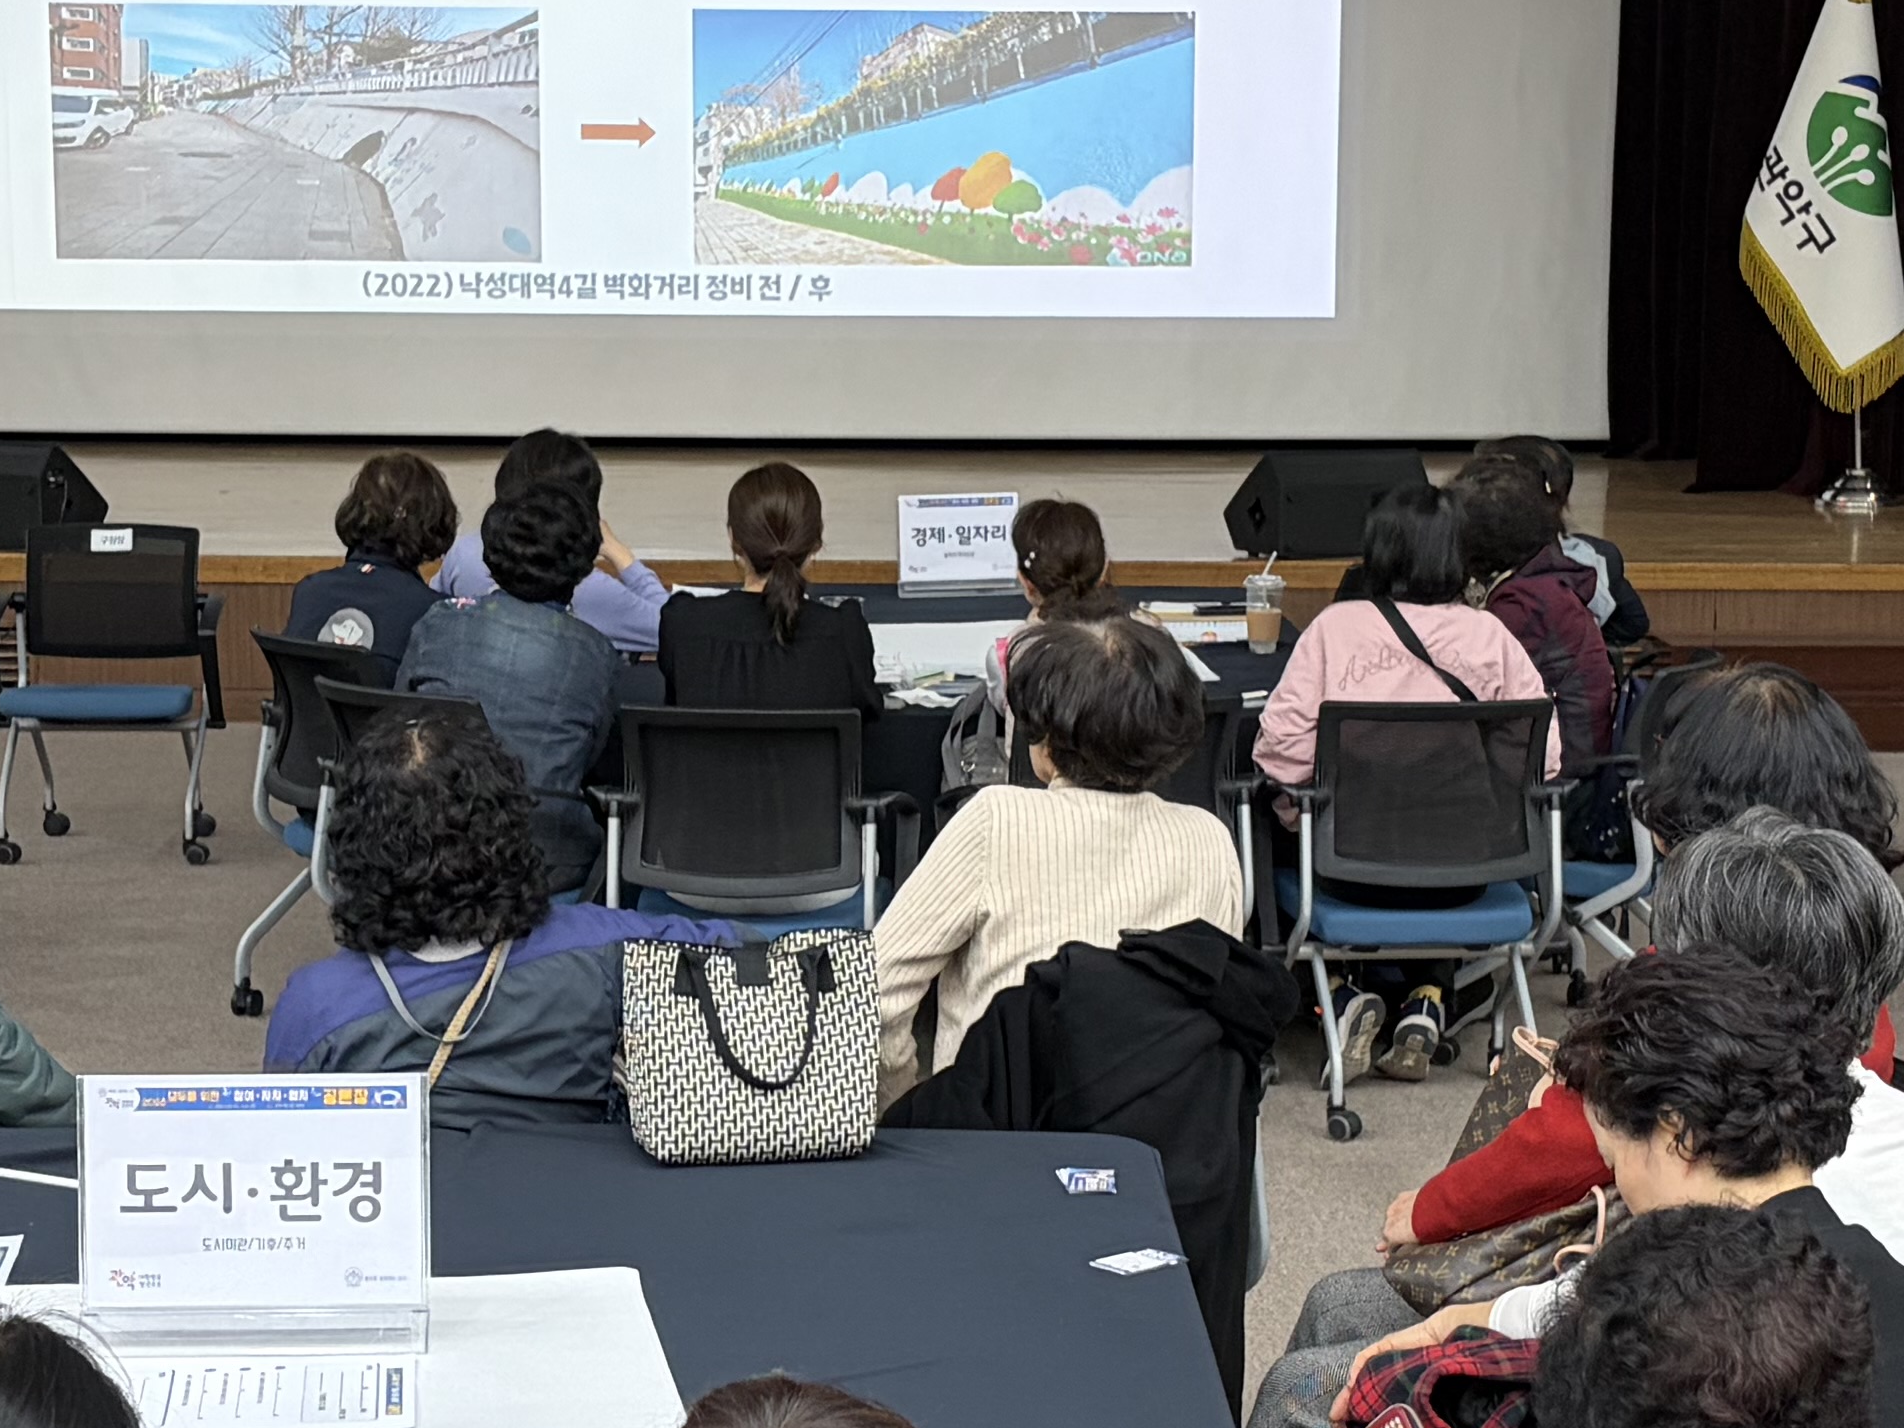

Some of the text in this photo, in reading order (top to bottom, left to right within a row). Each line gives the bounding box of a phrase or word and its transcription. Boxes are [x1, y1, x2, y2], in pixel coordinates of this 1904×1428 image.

[1756, 144, 1837, 255] 관악구
[361, 271, 455, 300] (2022)
[458, 272, 598, 301] 낙성대역4길
[603, 272, 697, 302] 벽화거리
[704, 273, 754, 302] 정비
[758, 273, 783, 302] 전
[807, 274, 833, 302] 후
[910, 524, 1007, 548] 경제·일자리
[119, 1158, 383, 1223] 도시·환경
